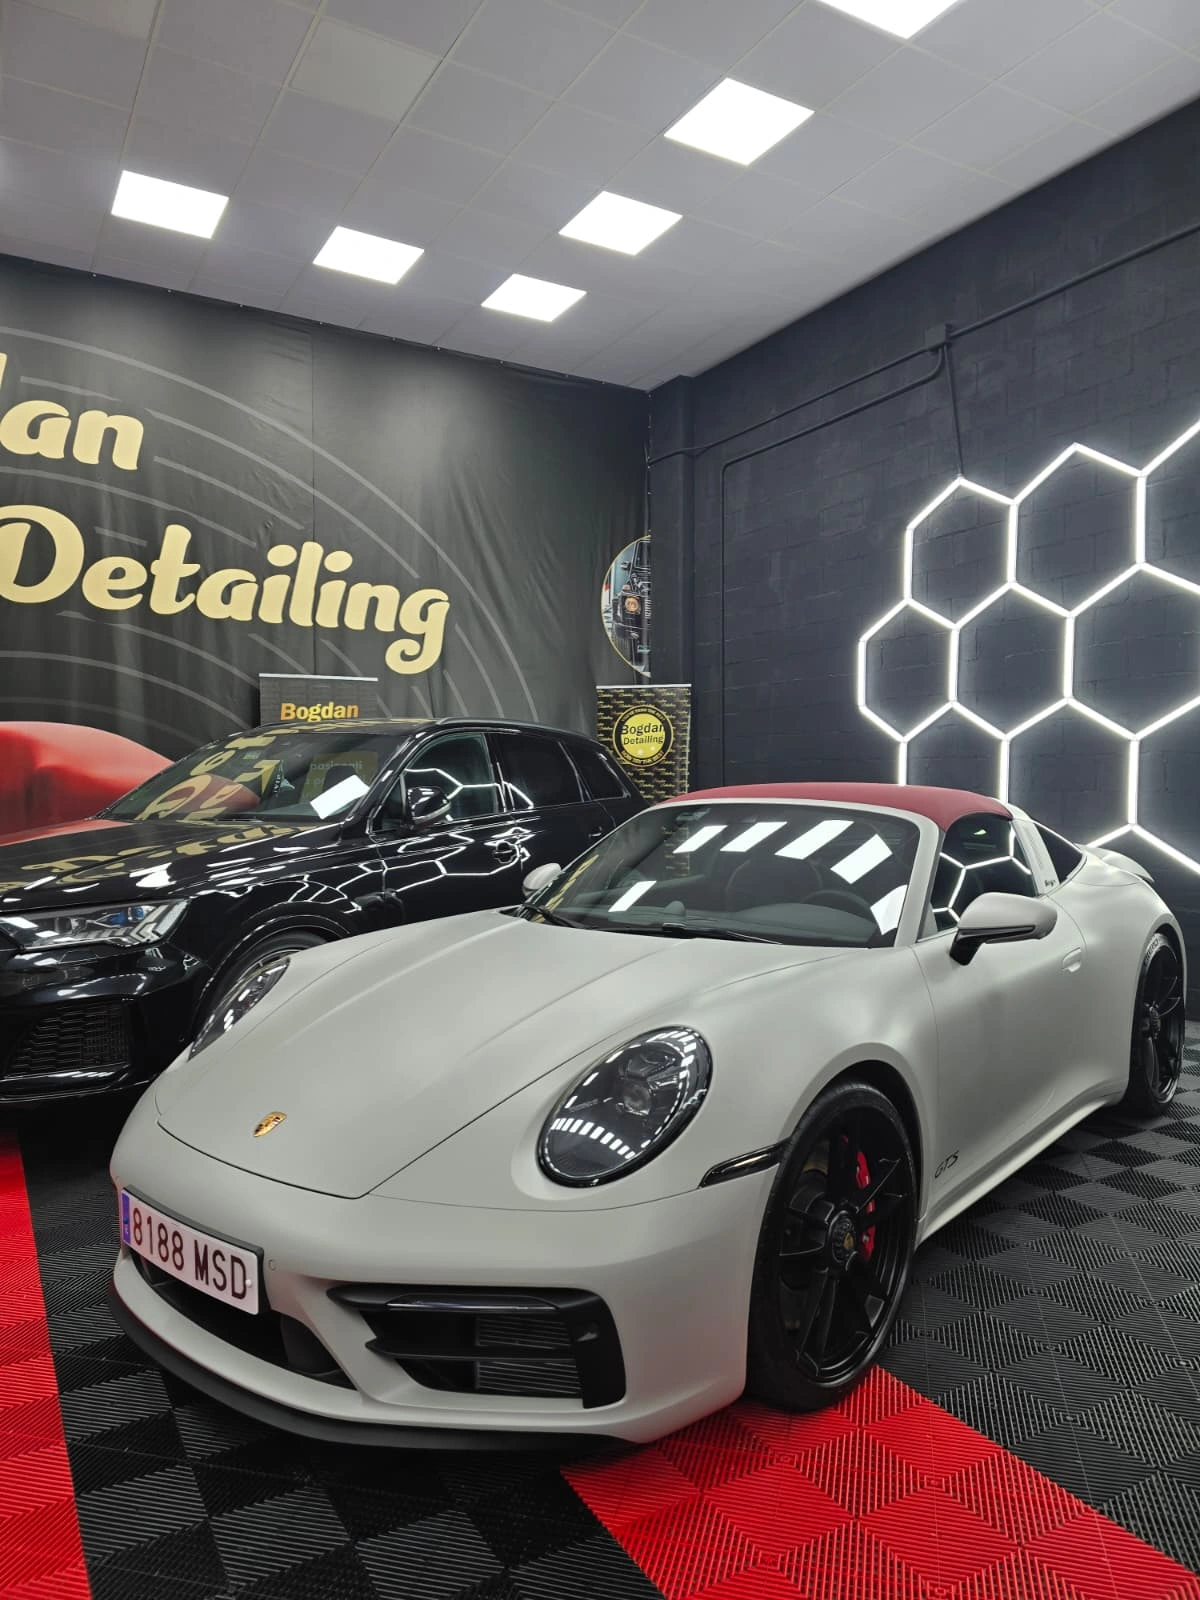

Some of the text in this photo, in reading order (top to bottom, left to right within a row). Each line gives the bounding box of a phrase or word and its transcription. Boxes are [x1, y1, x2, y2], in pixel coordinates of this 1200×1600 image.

[0, 352, 144, 471] an
[0, 504, 450, 674] Detailing
[280, 701, 359, 723] Bogdan
[623, 735, 664, 745] Detailing
[934, 1149, 960, 1179] GTS
[133, 1207, 247, 1300] 8188 MSD
